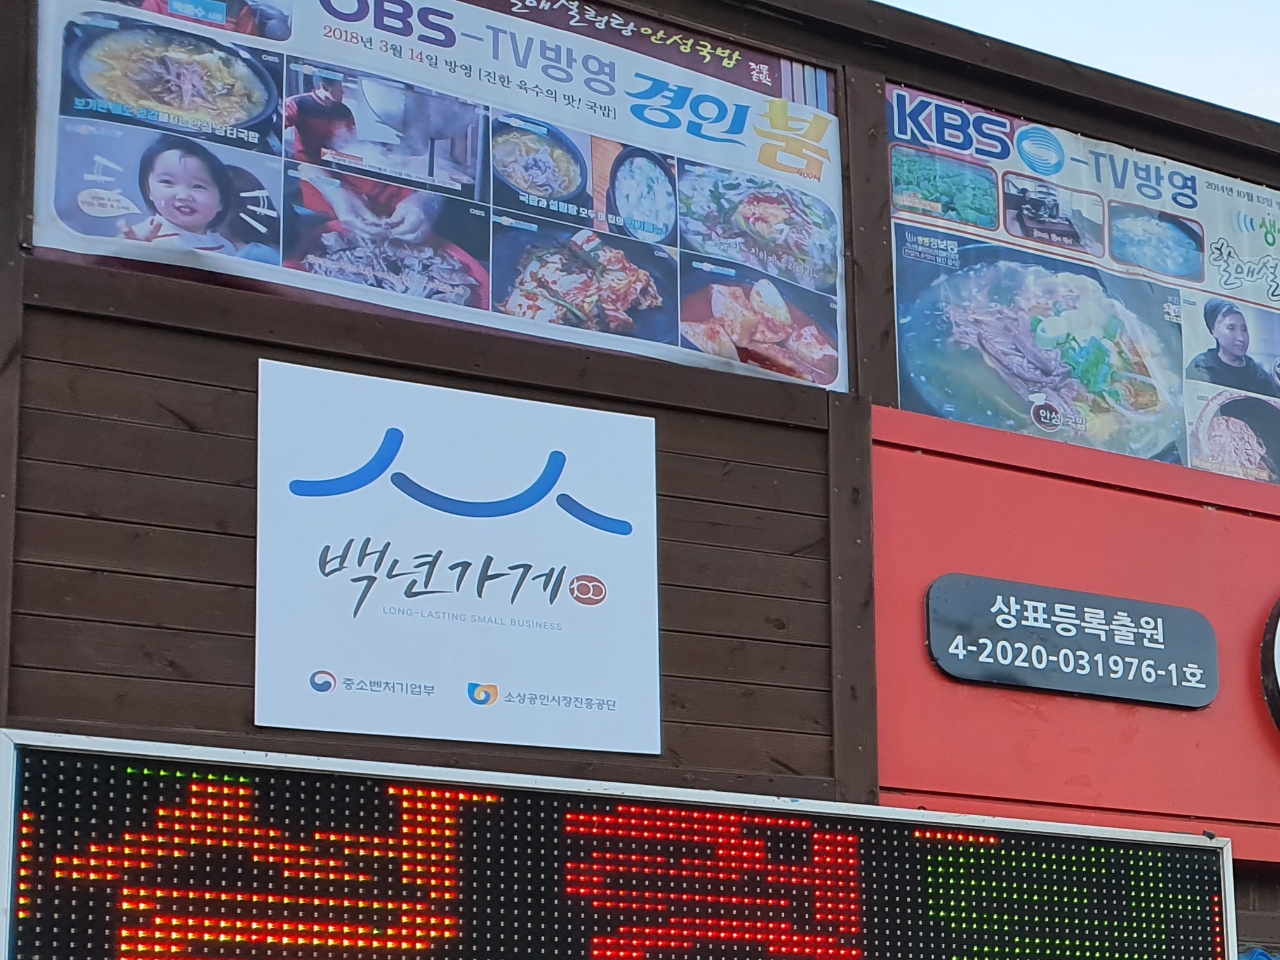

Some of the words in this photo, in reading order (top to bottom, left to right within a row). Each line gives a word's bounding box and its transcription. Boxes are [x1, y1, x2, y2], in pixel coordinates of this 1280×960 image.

[640, 26, 742, 68] 안성국밥
[322, 25, 374, 50] 2018년
[378, 40, 404, 59] 3월
[408, 48, 439, 69] 14일
[443, 59, 473, 78] 방영
[478, 66, 513, 88] [진한
[515, 79, 558, 103] 육수의
[562, 92, 582, 110] 맛!
[585, 102, 618, 120] 국밥]
[624, 72, 752, 147] 경인
[893, 89, 1014, 162] KBS
[1205, 180, 1234, 198] 2014년
[1038, 409, 1063, 426] 안성
[1065, 415, 1087, 431] 국밥
[317, 536, 568, 619] 백년가게
[382, 605, 467, 623] LONG-LASTING
[469, 613, 507, 627] SMALL
[509, 618, 563, 632] BUSINESS
[989, 593, 1167, 651] 상표등록출원
[341, 676, 436, 698] 중소벤처기업부
[947, 635, 1207, 691] 4-2020-031976-1호
[503, 690, 618, 713] 소상공인시장진흥공단
